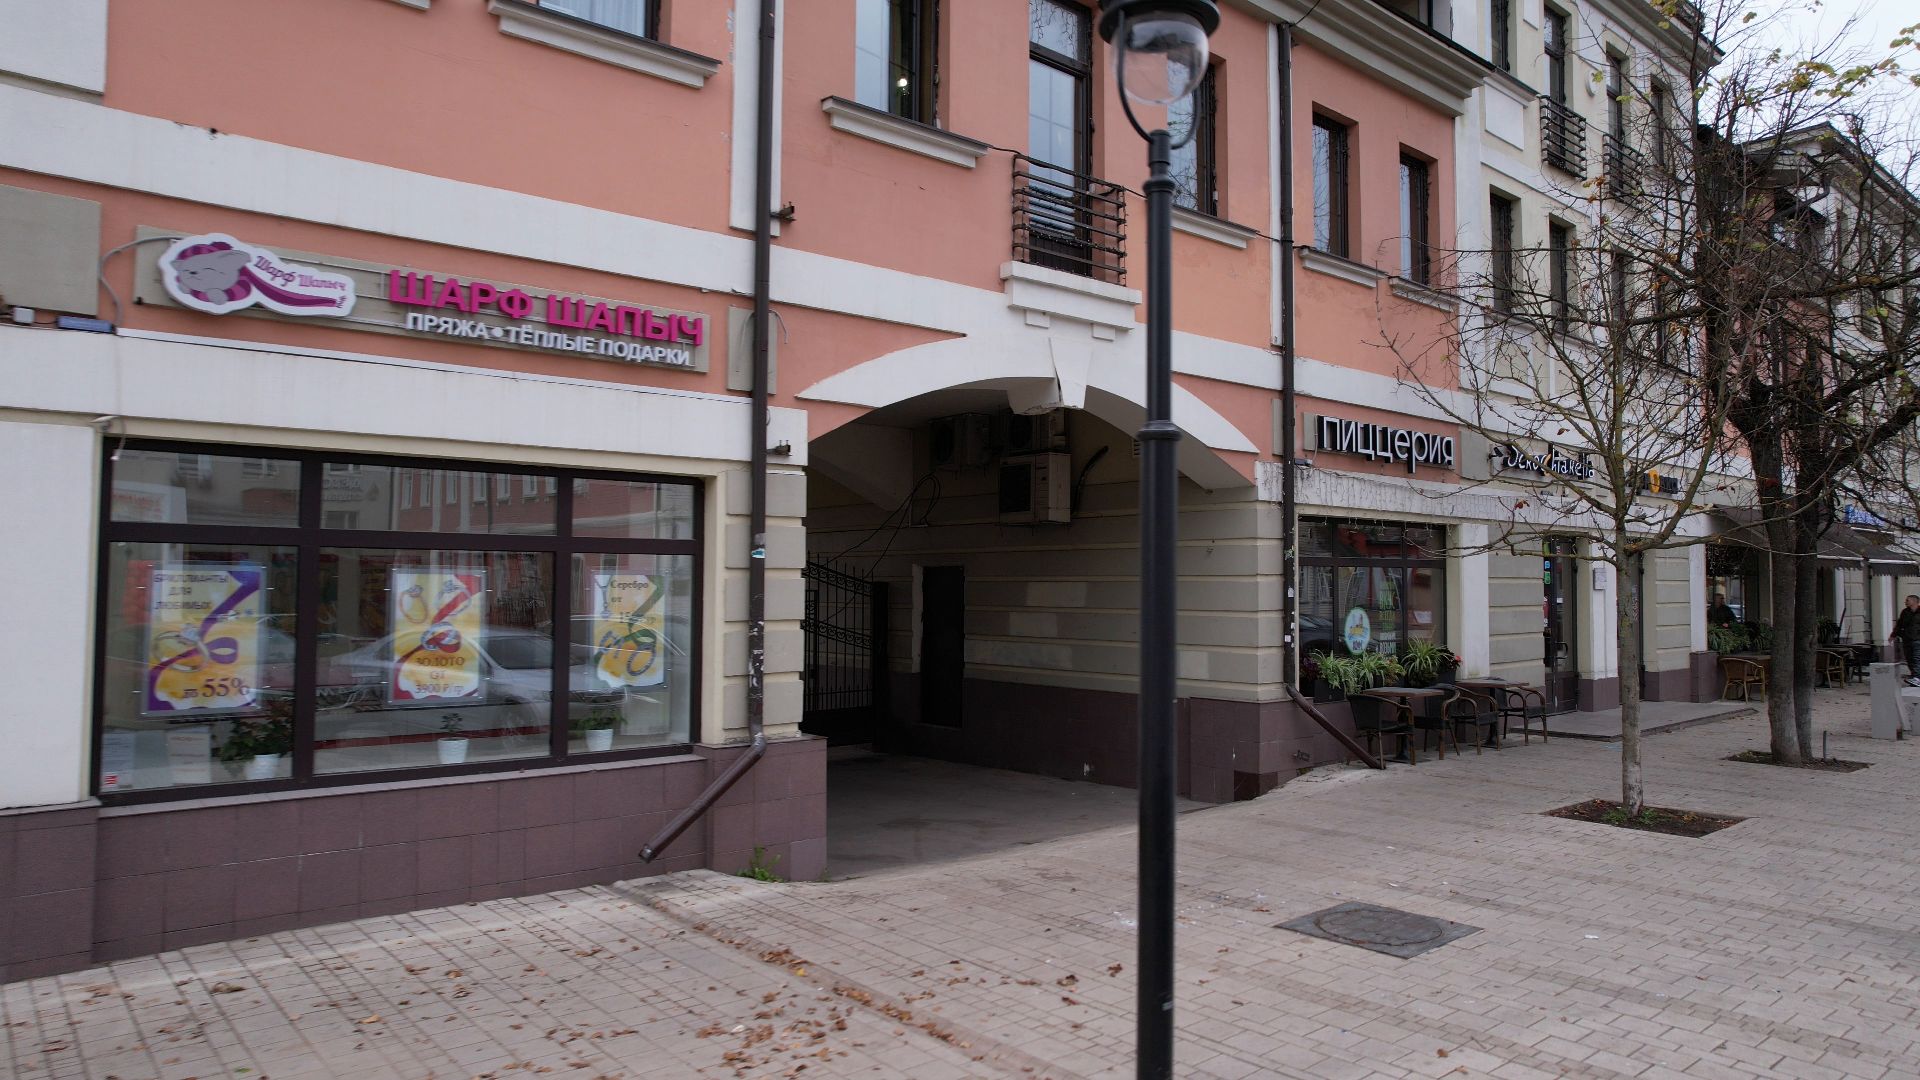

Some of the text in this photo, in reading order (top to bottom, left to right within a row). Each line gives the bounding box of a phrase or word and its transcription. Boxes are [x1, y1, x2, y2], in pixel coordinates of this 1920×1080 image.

[254, 255, 296, 287] Шарф
[389, 269, 704, 346] ШАРФ ШАПЫЧ
[406, 312, 691, 367] ПРЯЖА ТЁПЛЫЕ ПОДАРКИ
[1318, 415, 1455, 474] пиццерия
[610, 579, 649, 591] Серебро
[202, 677, 250, 698] 55%
